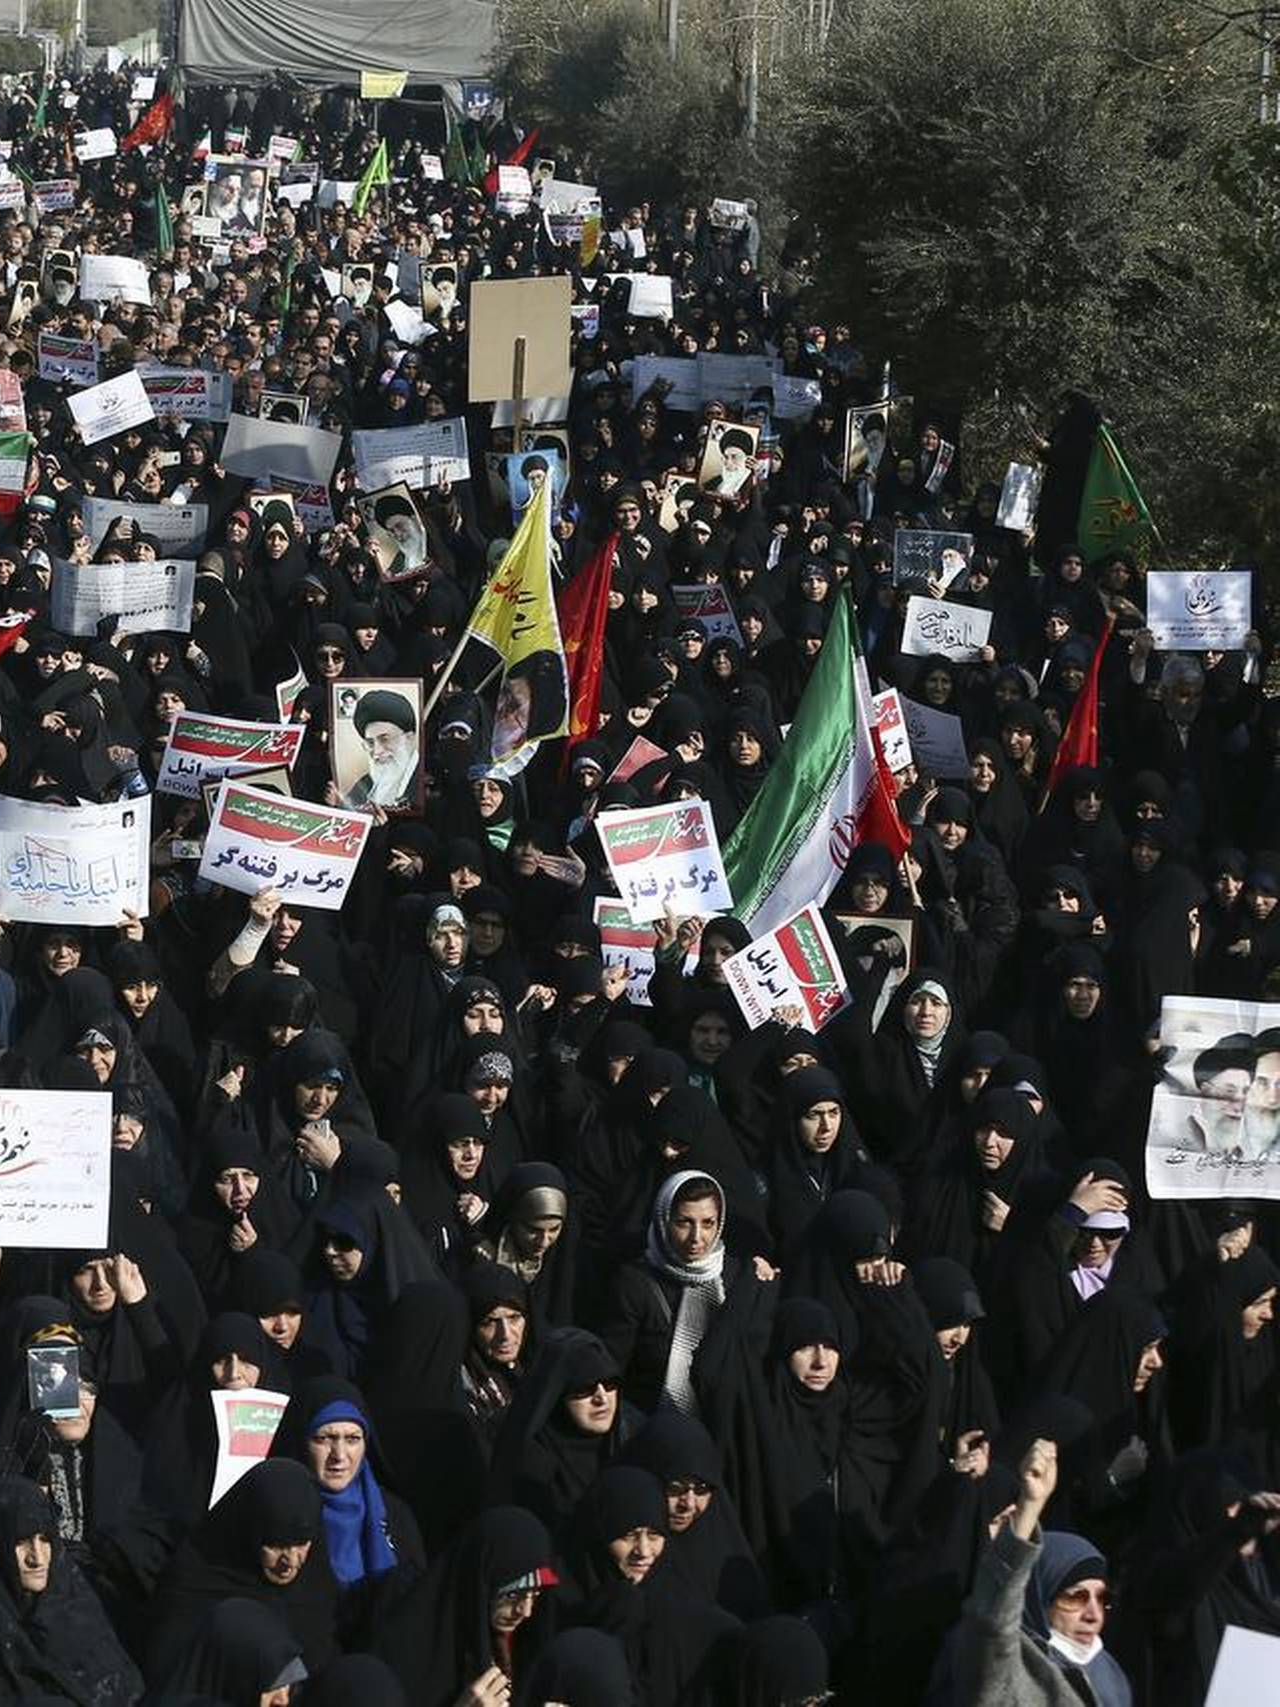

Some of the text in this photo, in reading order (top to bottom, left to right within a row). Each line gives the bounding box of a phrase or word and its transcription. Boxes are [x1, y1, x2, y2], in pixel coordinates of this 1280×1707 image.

[210, 847, 345, 894] مرگ بر فتنه گر
[680, 863, 719, 895] مرگ
[0, 1125, 31, 1166] نهم
